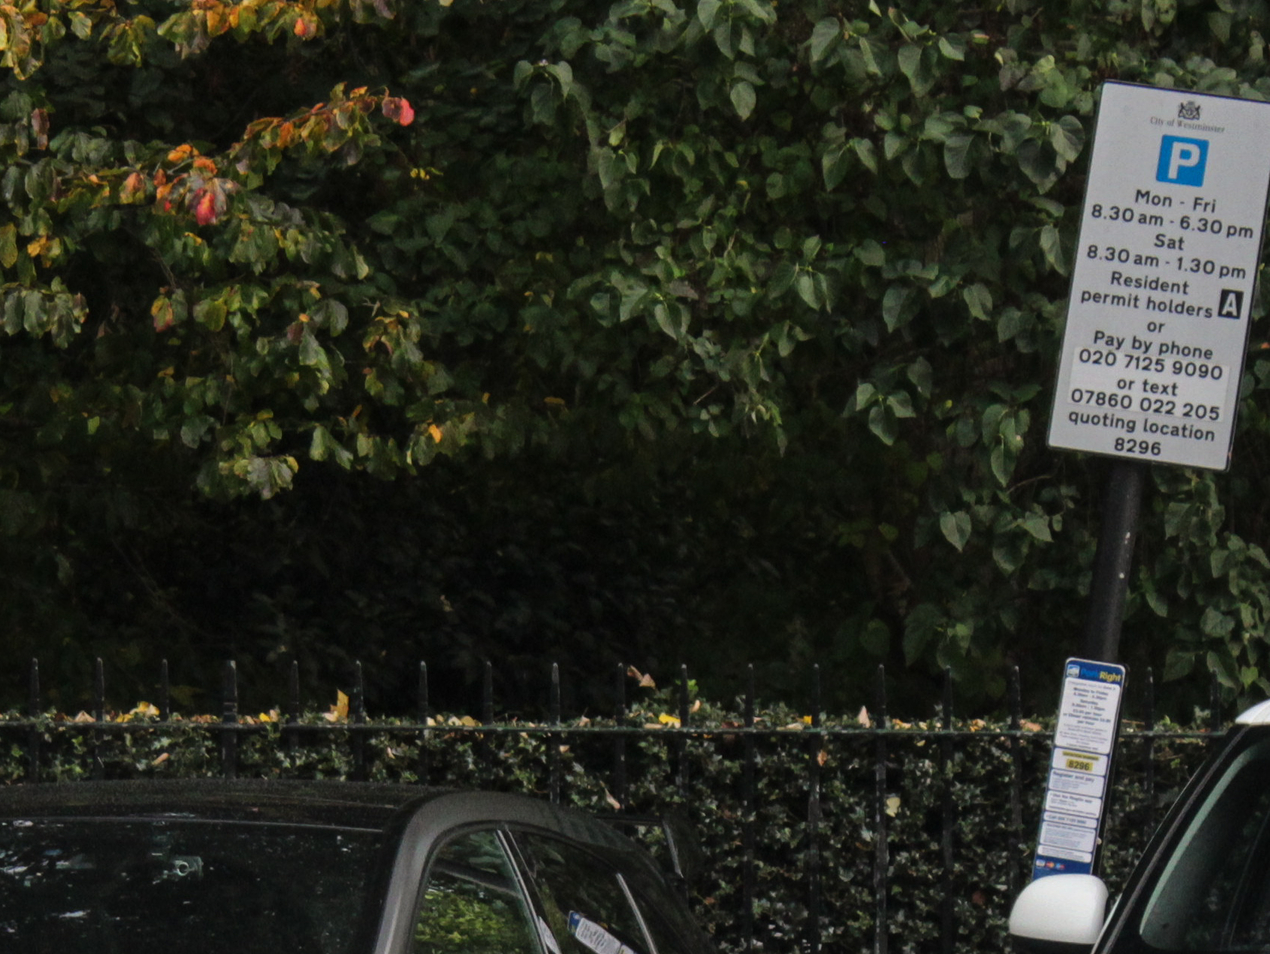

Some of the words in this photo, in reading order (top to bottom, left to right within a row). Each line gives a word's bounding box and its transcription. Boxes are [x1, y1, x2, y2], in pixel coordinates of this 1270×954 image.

[1150, 116, 1163, 127] City
[1167, 118, 1175, 126] of
[1177, 119, 1226, 134] Westminster
[1167, 141, 1201, 180] P
[1135, 189, 1172, 207] Mon
[1193, 197, 1216, 213] Fri
[1092, 204, 1134, 222] 8.30
[1138, 213, 1164, 227] am
[1180, 216, 1223, 235] 6.30
[1226, 224, 1254, 239] pm
[1154, 233, 1185, 250] Sat
[1087, 244, 1130, 263] 8.30
[1133, 253, 1159, 267] am
[1177, 257, 1215, 275] 1.30
[1219, 265, 1246, 279] pm
[1111, 271, 1189, 295] Resident
[1081, 290, 1139, 309] permit
[1146, 296, 1213, 318] holders
[1221, 292, 1238, 317] A
[1147, 321, 1165, 333] or
[1094, 331, 1125, 350] Pay
[1132, 335, 1153, 354] by
[1159, 341, 1213, 360] phone
[1079, 349, 1117, 366] 020
[1124, 354, 1165, 373] 7125
[1172, 360, 1223, 380] 9090
[1117, 378, 1134, 390] or
[1142, 380, 1179, 396] text
[1071, 388, 1133, 409] 07860
[1140, 397, 1176, 416] 022
[1182, 402, 1220, 421] 205
[1068, 411, 1136, 433] quoting
[1143, 418, 1216, 442] location
[1114, 437, 1161, 456] 8296
[1068, 760, 1091, 771] 8296
